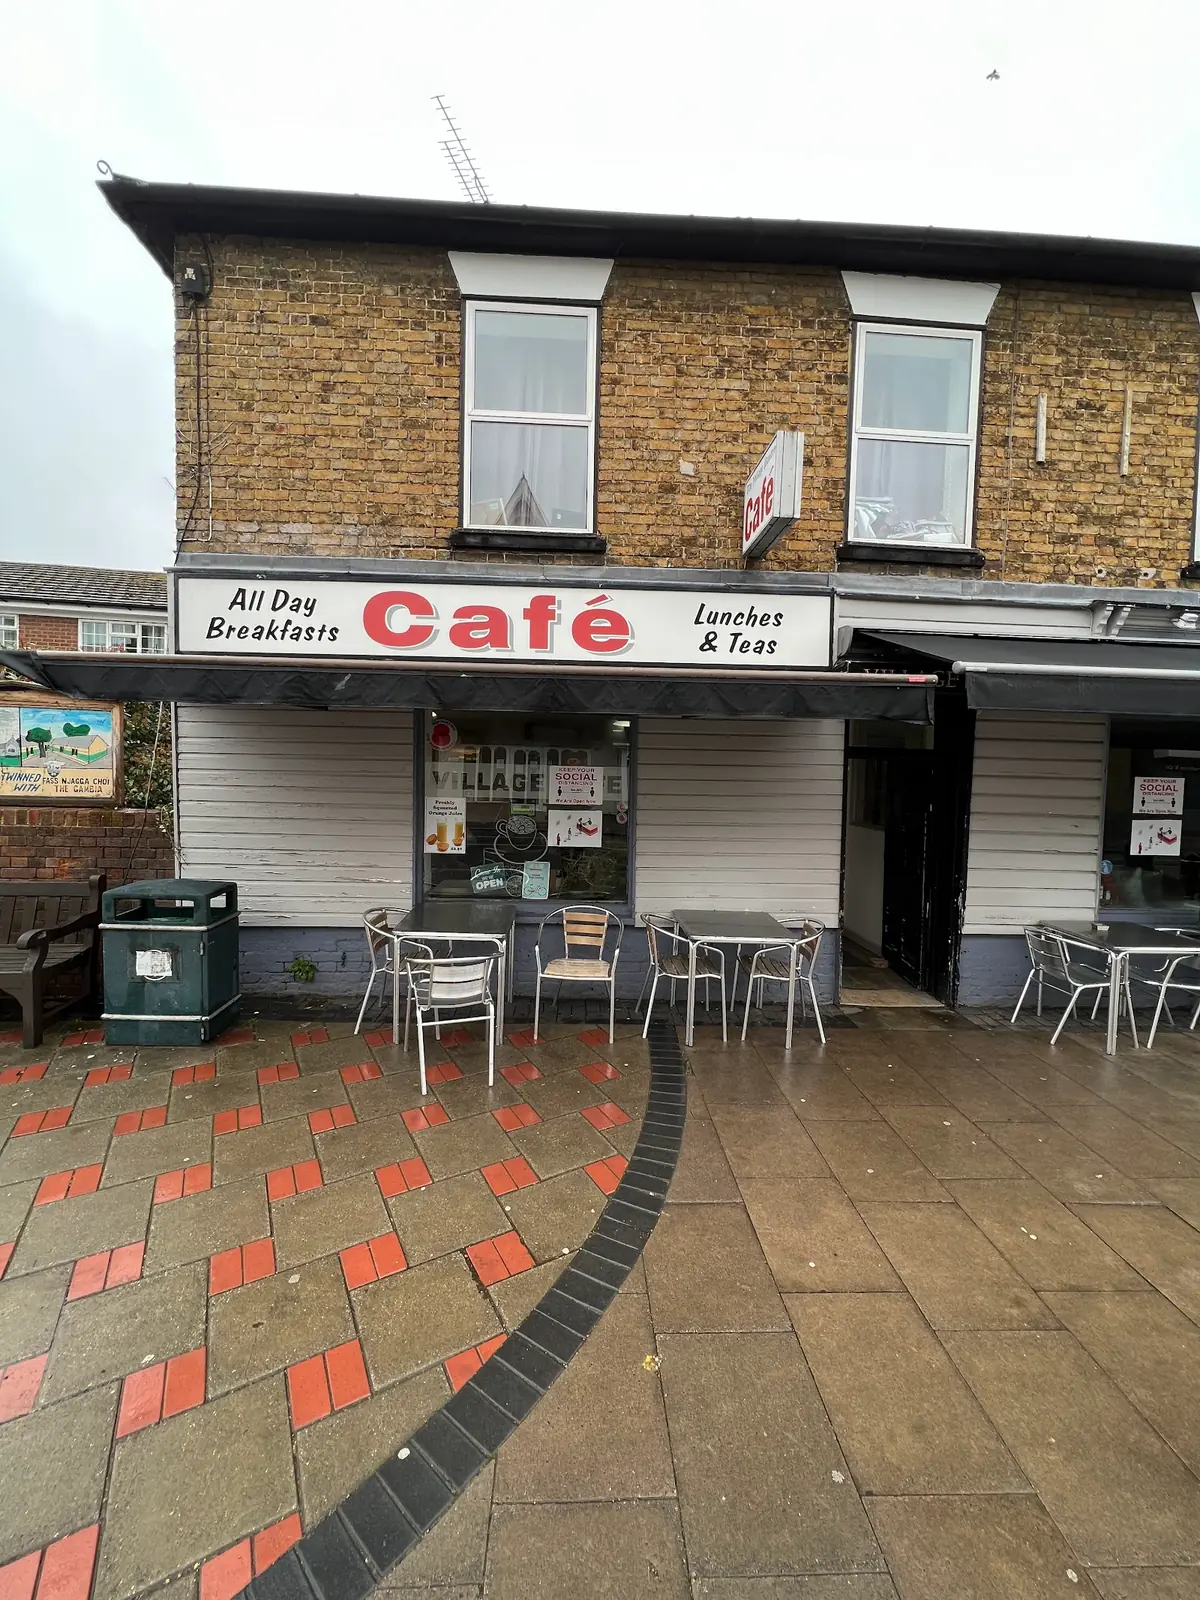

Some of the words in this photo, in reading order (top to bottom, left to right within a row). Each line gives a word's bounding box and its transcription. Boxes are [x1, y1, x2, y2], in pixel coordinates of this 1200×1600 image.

[744, 465, 774, 542] Café
[228, 587, 265, 612] All
[271, 588, 317, 618] Day
[363, 590, 634, 654] Café
[694, 602, 784, 628] Lunches
[206, 616, 340, 642] Breakfasts
[699, 631, 718, 652] &
[729, 632, 778, 655] Teas
[13, 782, 41, 792] WITH
[42, 777, 59, 785] FASS
[432, 770, 545, 792] VILLAGE
[555, 772, 597, 781] SOCIAL
[1139, 783, 1178, 792] SOCIAL
[55, 785, 69, 793] THE
[73, 785, 103, 793] GAMBIA
[475, 877, 504, 890] OPEN
